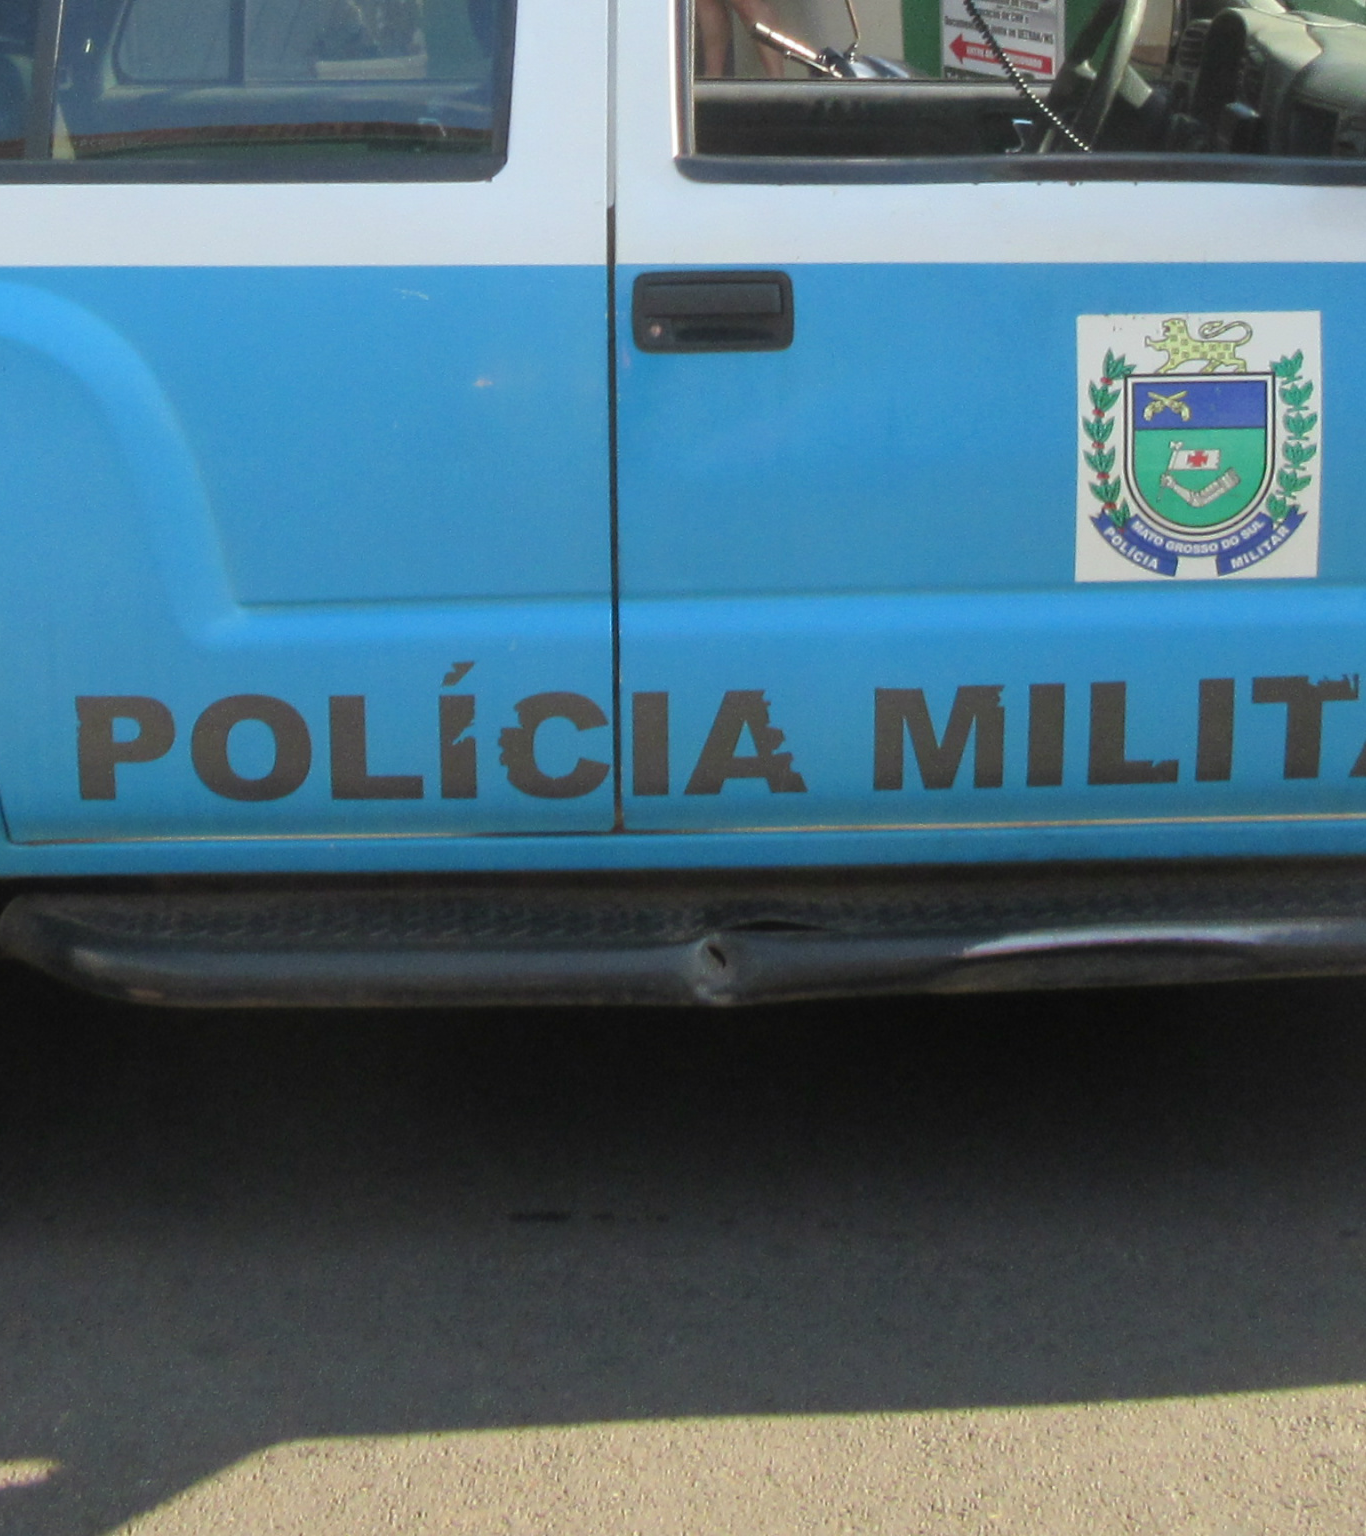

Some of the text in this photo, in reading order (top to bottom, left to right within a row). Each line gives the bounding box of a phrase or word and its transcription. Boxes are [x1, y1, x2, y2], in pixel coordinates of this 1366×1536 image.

[1131, 519, 1266, 555] MATO GROSSO DO SUL
[1231, 525, 1290, 570] MILITAR
[74, 660, 807, 802] POLÍCIA
